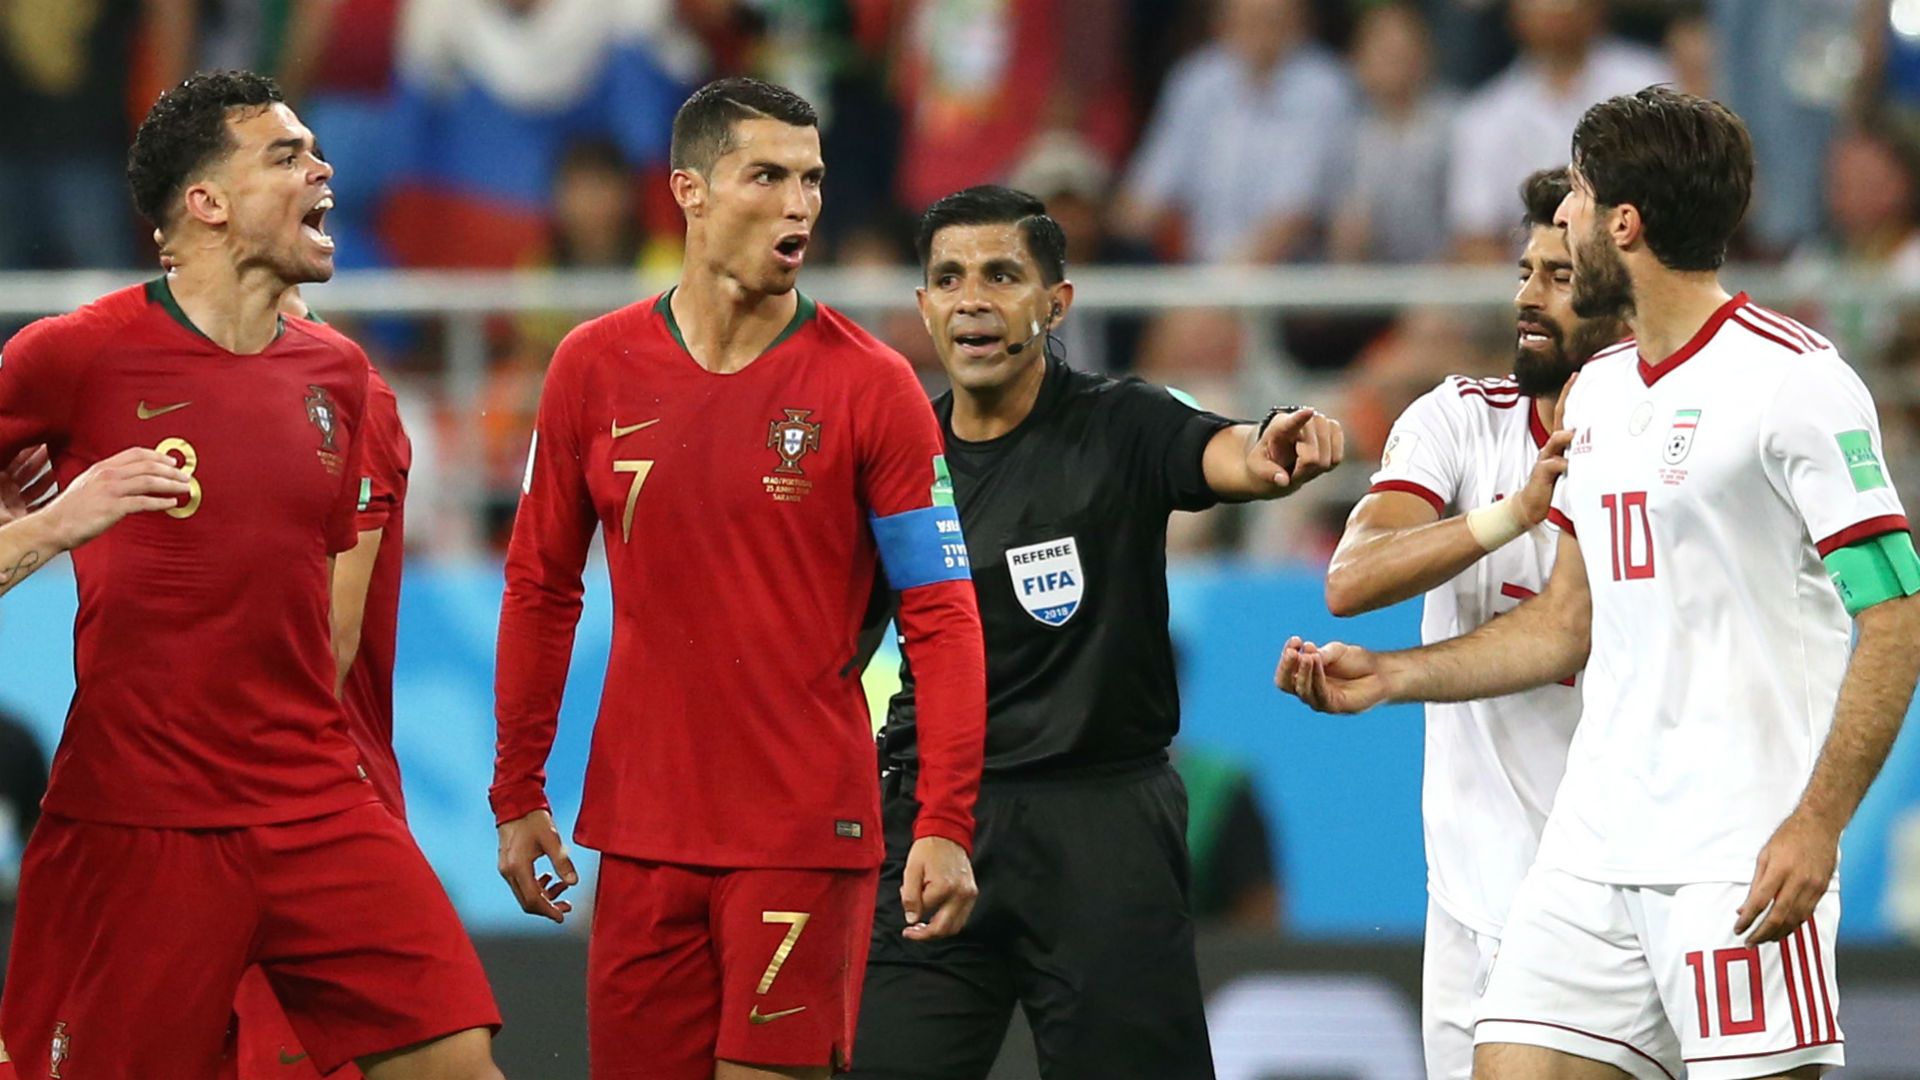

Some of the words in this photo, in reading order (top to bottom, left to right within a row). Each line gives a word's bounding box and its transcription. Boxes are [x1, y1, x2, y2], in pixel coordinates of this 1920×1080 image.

[154, 437, 202, 519] 8
[613, 460, 655, 544] 7
[935, 519, 961, 533] FIFA
[1012, 543, 1072, 566] REFEREE
[1601, 491, 1655, 582] 10
[1022, 570, 1076, 596] FIFA
[1044, 606, 1070, 620] 2018
[756, 911, 811, 994] 7
[1685, 944, 1767, 1039] 10
